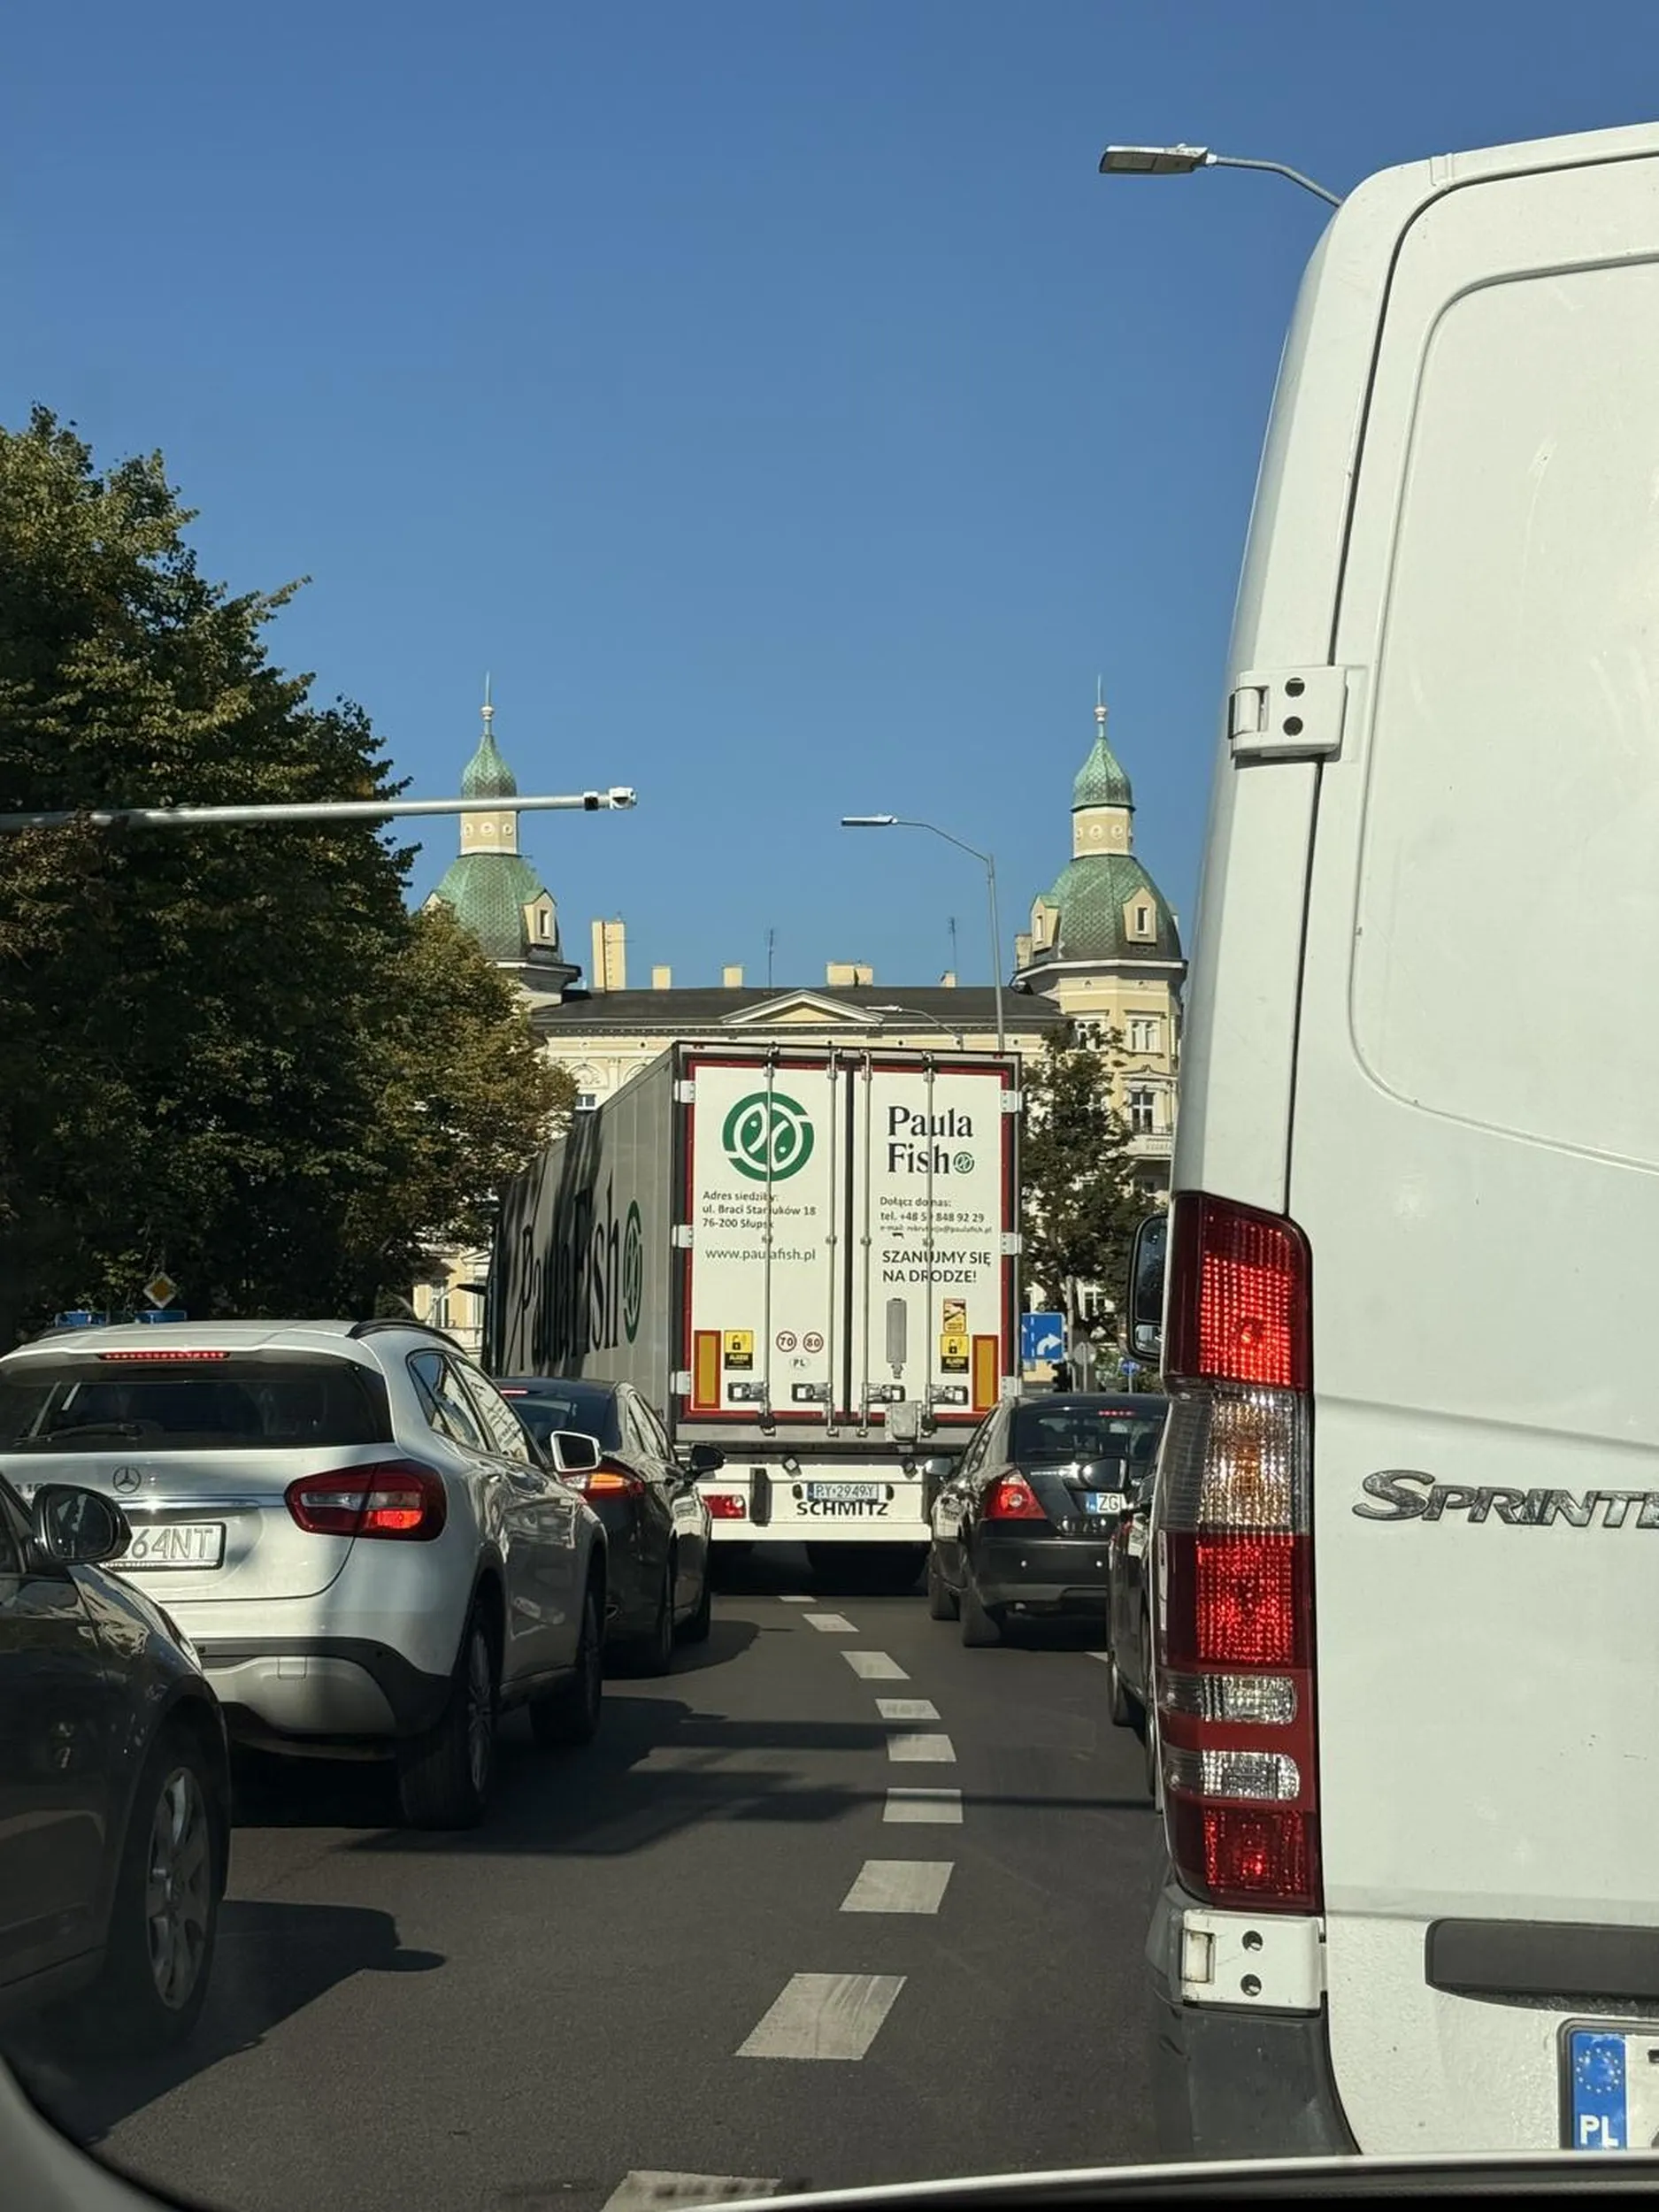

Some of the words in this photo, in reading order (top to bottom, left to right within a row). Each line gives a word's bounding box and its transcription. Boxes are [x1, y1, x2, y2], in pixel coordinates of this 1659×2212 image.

[888, 1106, 973, 1137] Paula
[887, 1143, 949, 1174] Fish
[703, 1191, 733, 1200] Adres
[915, 1197, 928, 1207] do
[703, 1204, 716, 1214] ul.
[718, 1204, 744, 1215] Braci
[804, 1206, 816, 1216] 18
[703, 1218, 739, 1228] 76-200
[880, 1211, 897, 1221] tel.
[901, 1212, 918, 1221] +48
[935, 1212, 955, 1222] 848
[957, 1213, 970, 1222] 92
[972, 1213, 985, 1223] 29
[882, 1251, 966, 1263] SZANUJMY
[969, 1252, 992, 1266] SIĘ
[883, 1270, 905, 1282] NA
[909, 1270, 977, 1283] DRODZE!
[780, 1337, 794, 1347] 70
[806, 1338, 820, 1348] 80
[796, 1502, 889, 1516] SCHMITZ
[1579, 2113, 1620, 2147] PL
